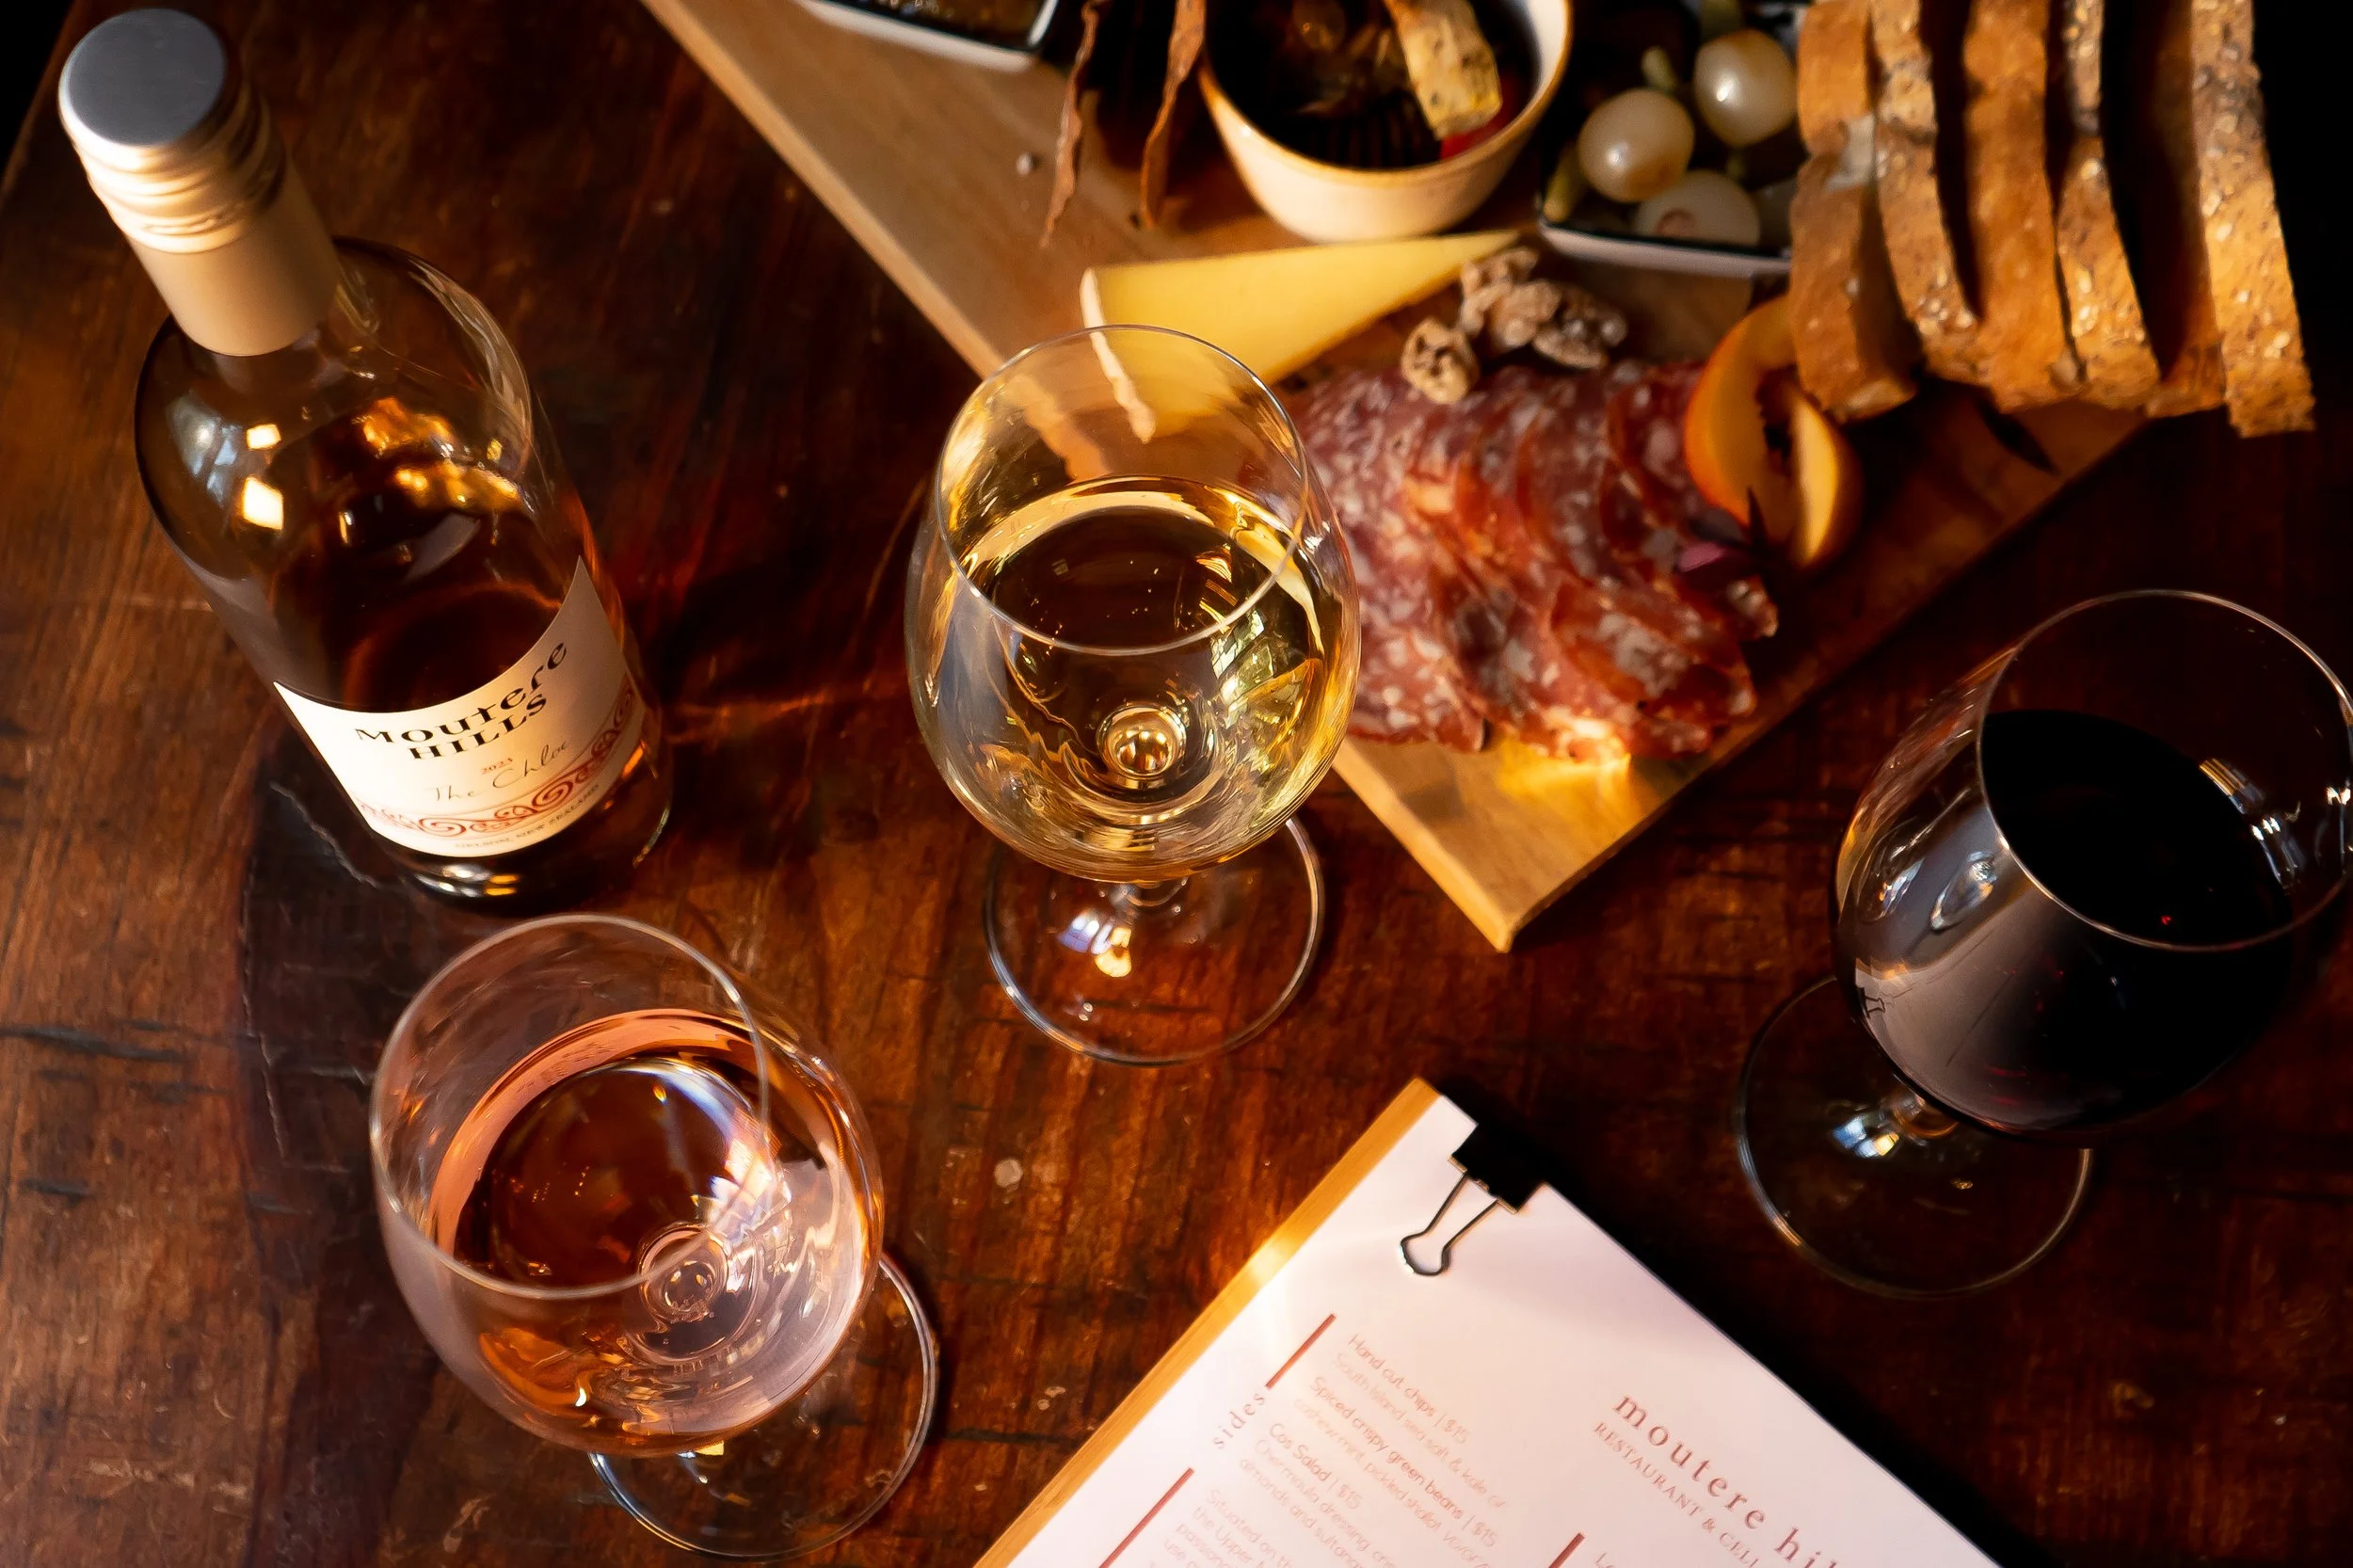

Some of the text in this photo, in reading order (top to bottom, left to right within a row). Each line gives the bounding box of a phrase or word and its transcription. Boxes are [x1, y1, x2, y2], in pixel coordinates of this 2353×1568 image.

[408, 694, 547, 760] HILLS
[433, 784, 481, 802] The
[1348, 1334, 1386, 1370] Hand
[1382, 1368, 1405, 1389] cut
[1404, 1387, 1436, 1416] chips
[1442, 1419, 1471, 1444] $15
[1213, 1393, 1265, 1449] sides
[1269, 1422, 1293, 1449] Cos
[1292, 1444, 1333, 1482] Salad
[1337, 1484, 1362, 1510] $15
[1310, 1376, 1356, 1419] Spiced
[1352, 1417, 1389, 1451] crispy
[1386, 1451, 1426, 1485] green
[1424, 1480, 1465, 1519] beans
[1472, 1522, 1498, 1547] $15
[1449, 1458, 1463, 1473] &
[1593, 1422, 1703, 1516] RESTAURANT
[1702, 1518, 1716, 1532] &
[1612, 1395, 1765, 1529] moutere
[1193, 1507, 1254, 1563] the Upper
[1207, 1488, 1262, 1543] Situated
[1260, 1542, 1276, 1560] on
[1289, 1505, 1318, 1529] and
[1320, 1503, 1371, 1551] dressing
[1163, 1539, 1185, 1560] use
